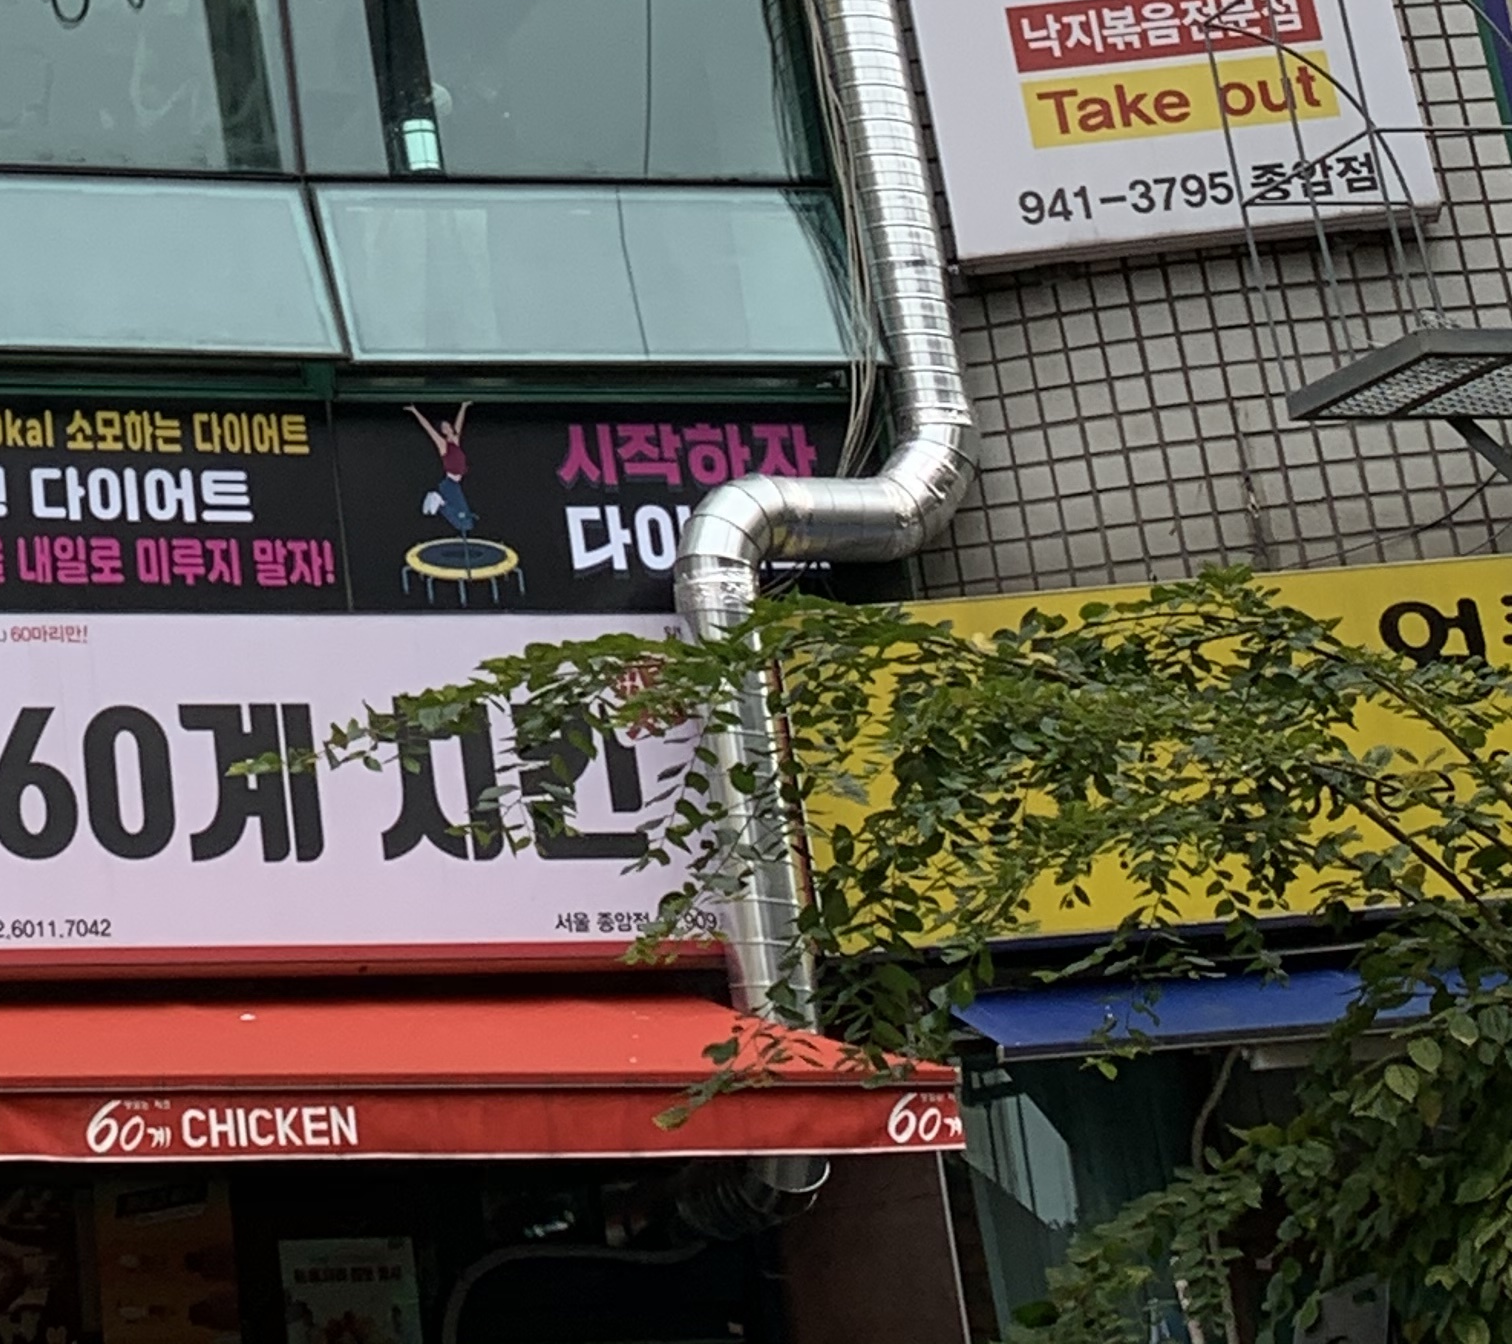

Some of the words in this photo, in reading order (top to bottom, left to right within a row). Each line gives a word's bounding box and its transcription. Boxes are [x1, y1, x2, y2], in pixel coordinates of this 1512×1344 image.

[1036, 83, 1192, 136] Take
[1218, 65, 1323, 117] out
[1018, 171, 1236, 226] 941-3795
[1250, 152, 1382, 204] 종암점
[66, 410, 184, 454] 소모하는
[194, 411, 311, 455] 다이어트
[556, 421, 819, 488] 시작하자
[30, 466, 255, 524] 다이어트
[17, 535, 126, 587] 내일로
[136, 536, 243, 588] 미루지
[253, 537, 336, 589] 말자!
[554, 911, 591, 934] 서울
[180, 1105, 359, 1149] CHICKEN
